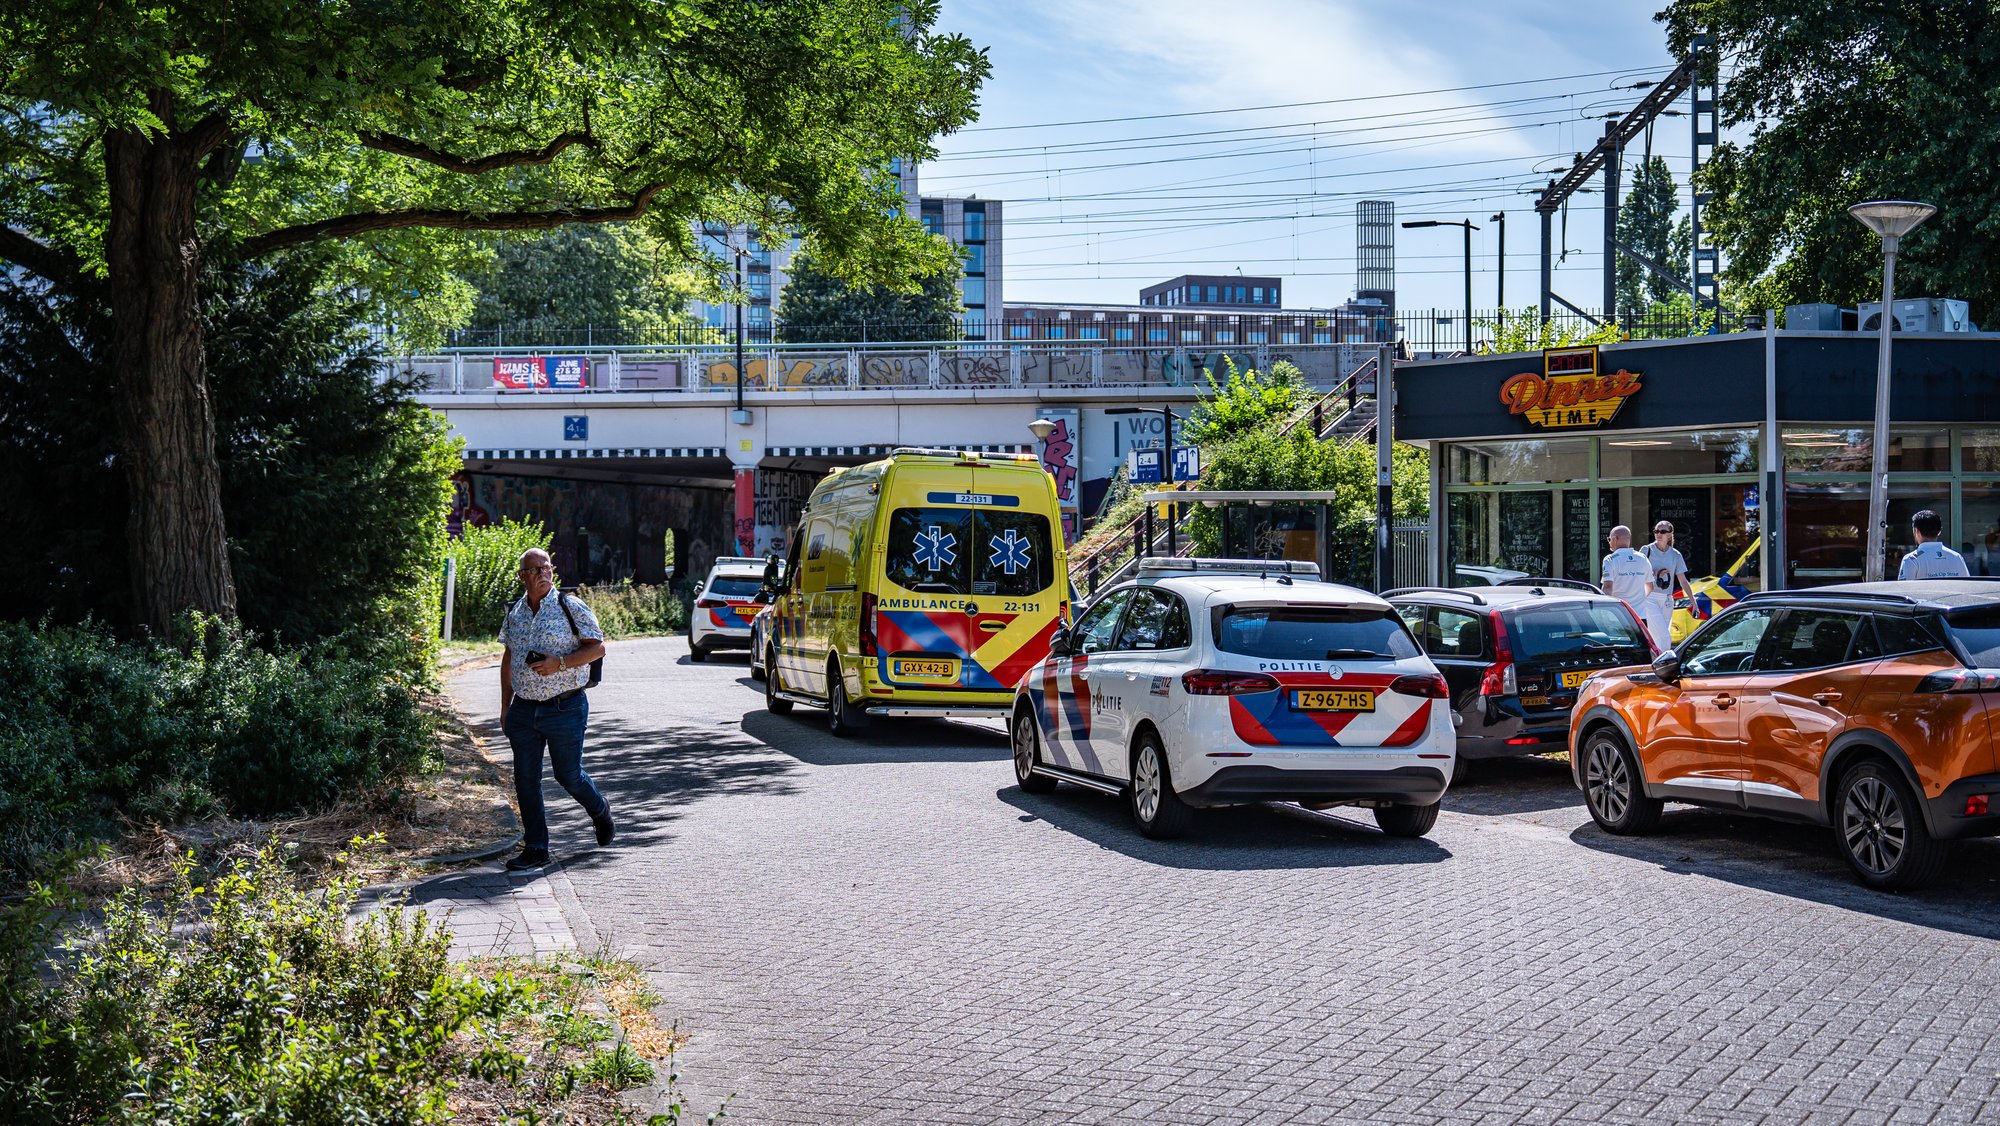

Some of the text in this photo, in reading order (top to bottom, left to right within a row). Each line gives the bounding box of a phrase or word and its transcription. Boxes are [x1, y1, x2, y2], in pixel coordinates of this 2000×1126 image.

[498, 363, 530, 374] JAMS
[559, 360, 579, 368] JUNE
[512, 374, 547, 385] GEMS
[1499, 368, 1642, 415] Dinner
[1542, 409, 1597, 425] TIME
[1140, 457, 1152, 465] 2-4
[879, 599, 1040, 612] AMBULANCE 22-131
[904, 662, 949, 673] GXX-42-B
[1259, 662, 1322, 671] POLITIE
[1161, 676, 1172, 688] 112
[1092, 694, 1122, 711] POLITIE
[1302, 693, 1367, 707] Z-967-HS
